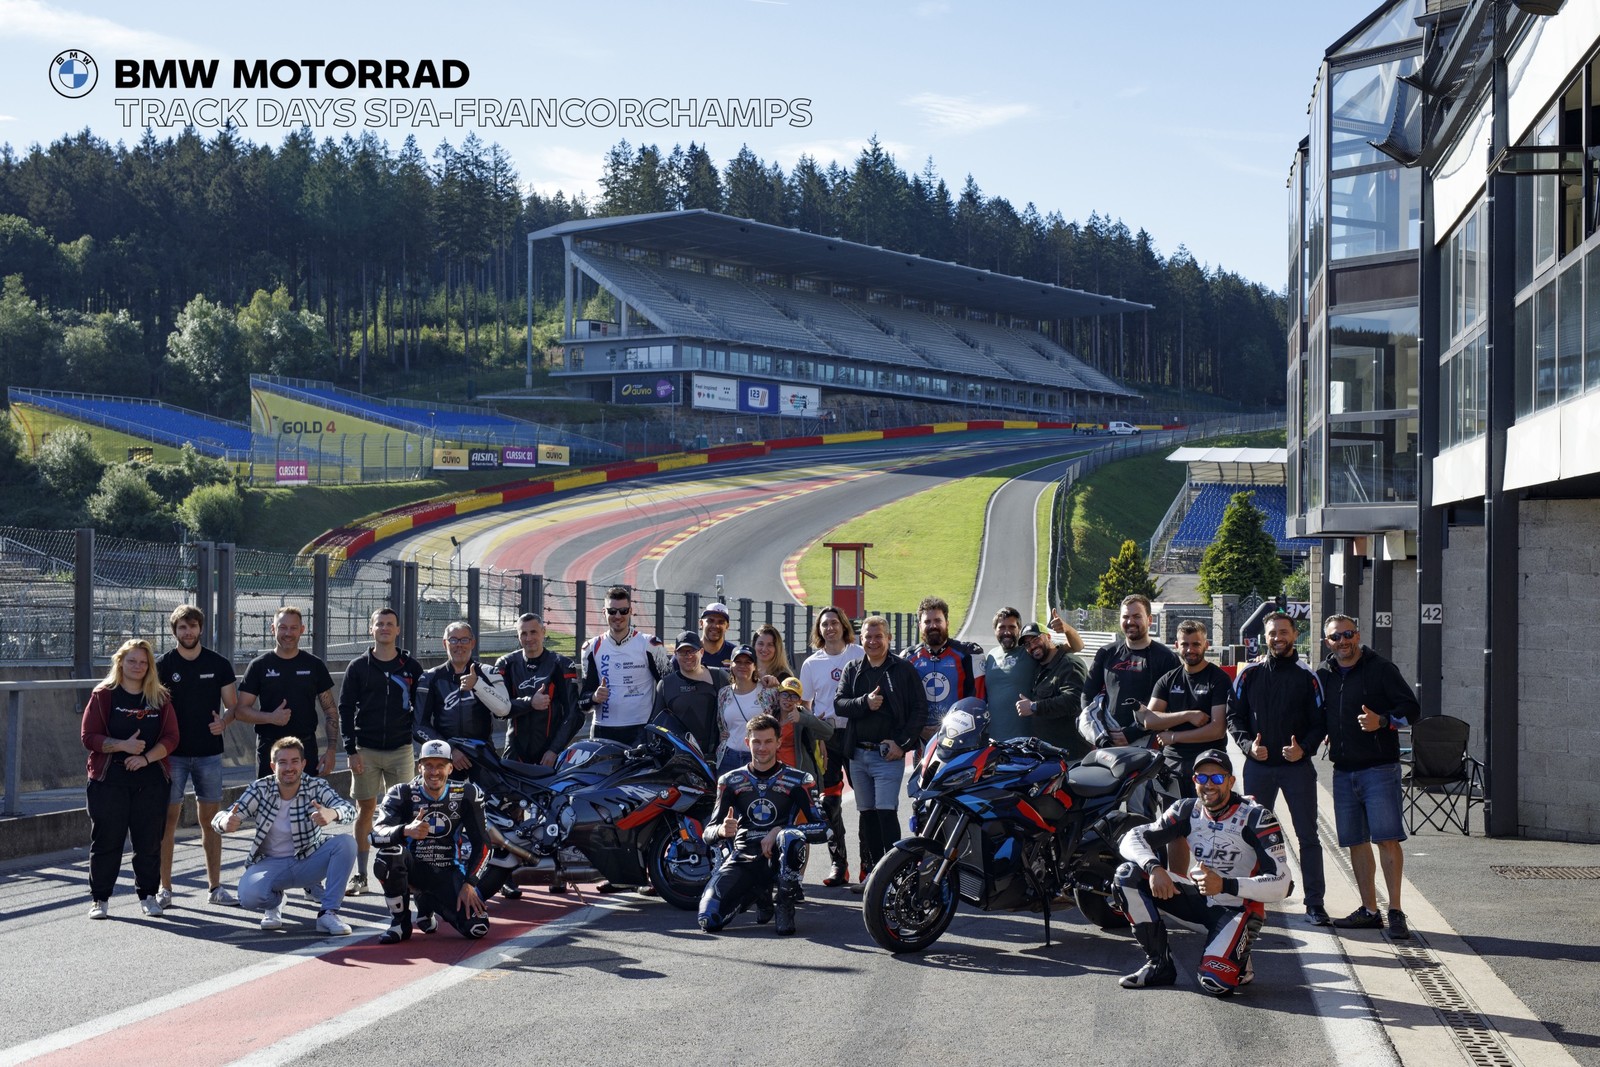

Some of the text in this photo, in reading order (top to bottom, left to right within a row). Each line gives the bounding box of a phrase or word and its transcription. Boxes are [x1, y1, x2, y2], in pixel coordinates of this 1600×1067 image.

[750, 389, 760, 399] 123
[282, 420, 336, 434] GOLD 4
[471, 452, 494, 462] AISIN
[505, 450, 526, 460] CLASSIC
[527, 451, 533, 461] 21
[278, 465, 299, 476] CLASSIC
[1375, 614, 1392, 626] 43
[1422, 607, 1442, 621] 42
[1194, 847, 1241, 861] BJRT
[1204, 959, 1236, 974] RST
